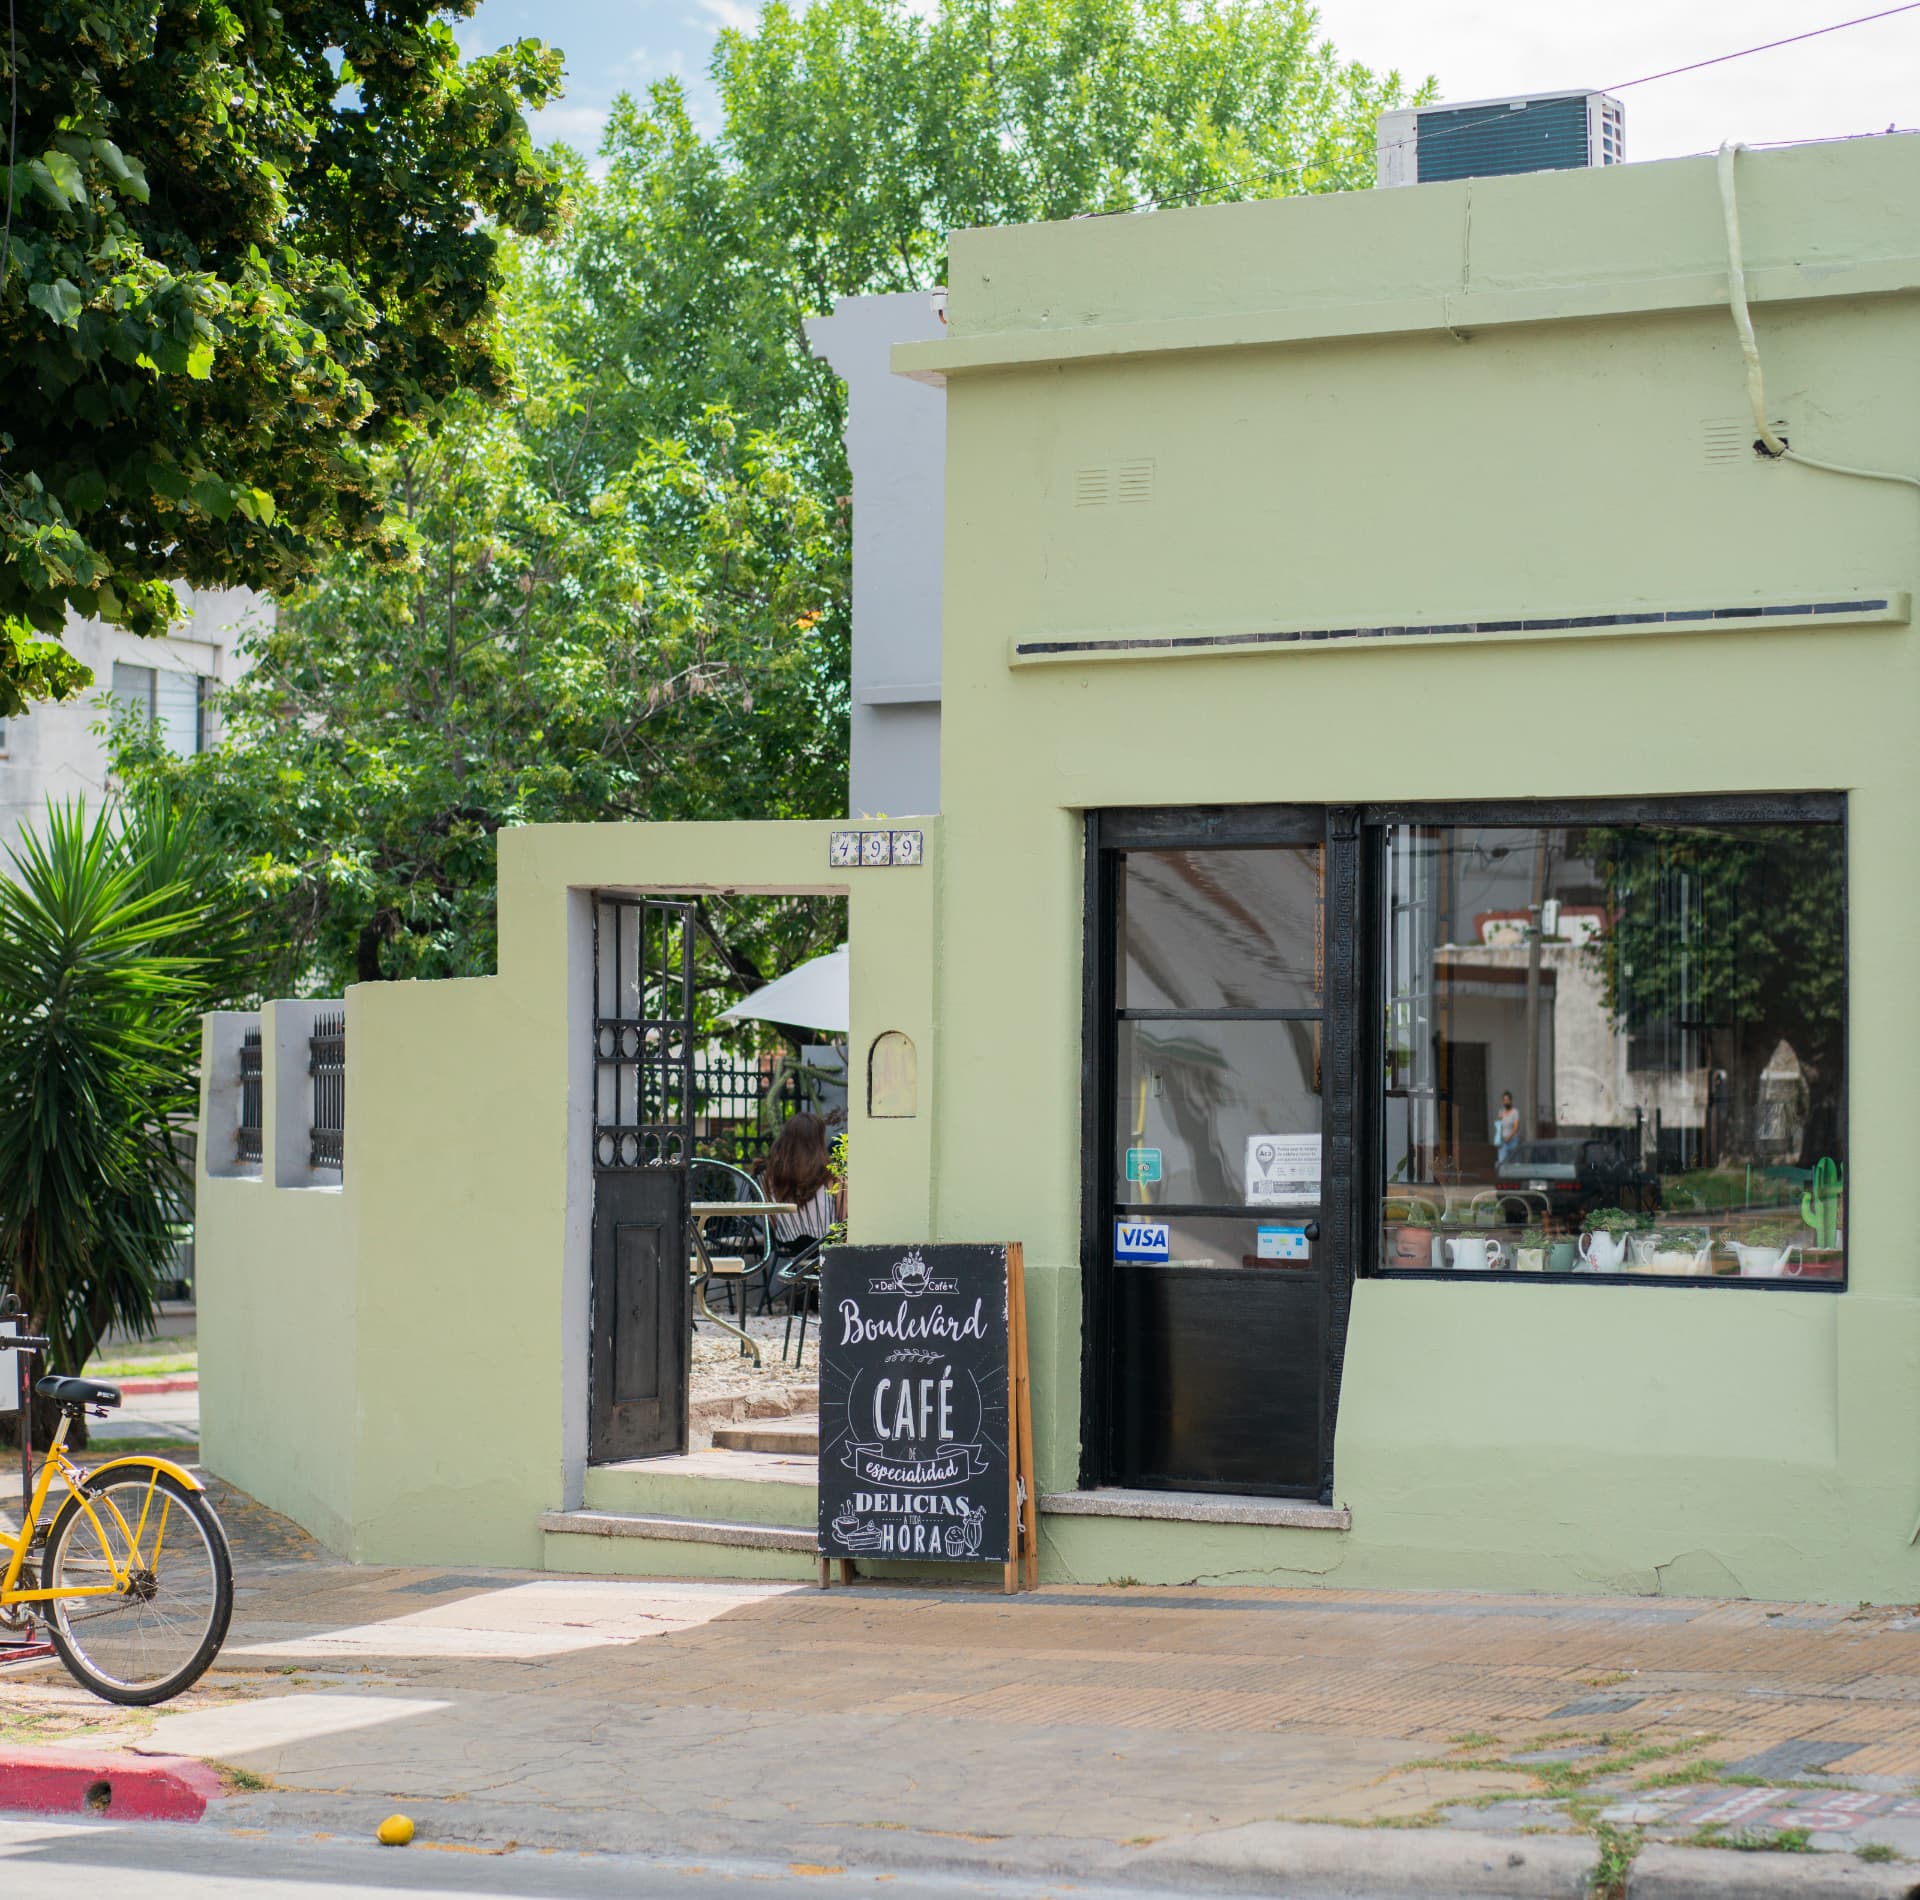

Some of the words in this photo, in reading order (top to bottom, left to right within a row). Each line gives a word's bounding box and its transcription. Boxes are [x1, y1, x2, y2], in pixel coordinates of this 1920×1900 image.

[839, 840, 912, 858] 499
[1123, 1228, 1167, 1248] VISA
[880, 1281, 897, 1291] Deli
[928, 1281, 948, 1291] Café
[838, 1298, 988, 1346] Boulevard
[873, 1365, 954, 1441] CAFÉ
[908, 1447, 917, 1460] DE
[866, 1459, 959, 1484] especialidad
[852, 1492, 970, 1517] DELICIAS
[881, 1524, 942, 1553] HORA
